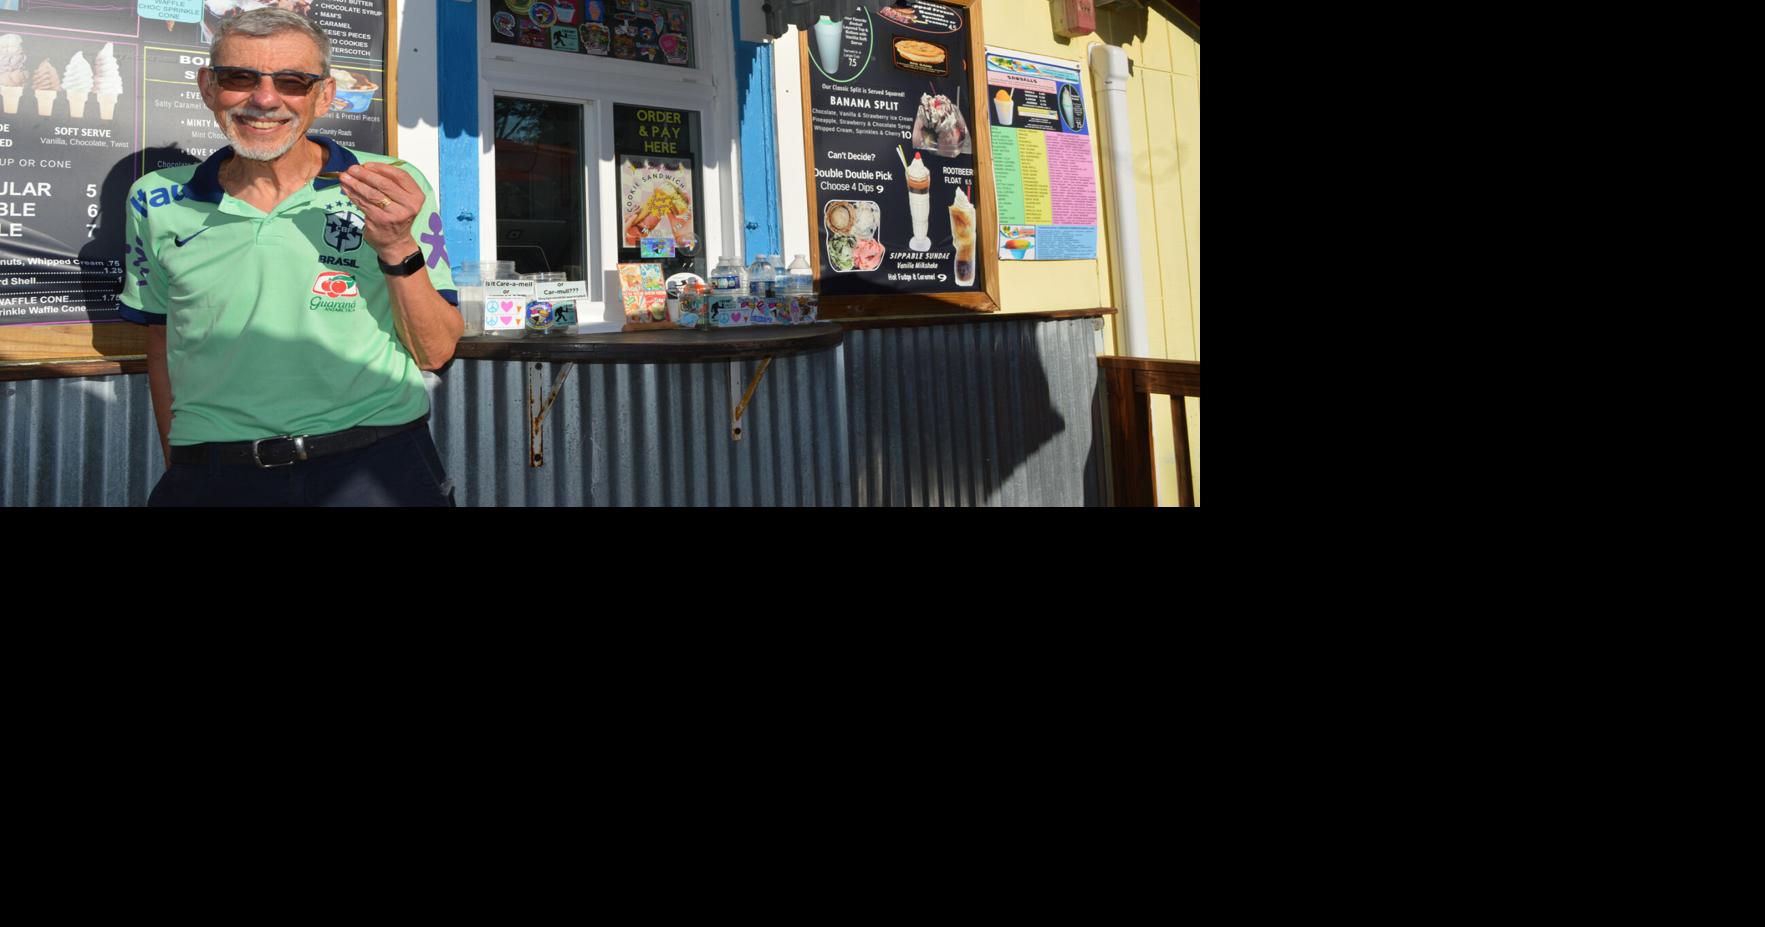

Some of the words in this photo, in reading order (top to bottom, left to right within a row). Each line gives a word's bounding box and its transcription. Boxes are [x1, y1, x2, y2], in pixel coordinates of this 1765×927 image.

[320, 3, 361, 14] CHOCOLATE
[362, 8, 382, 16] SYRUP
[319, 20, 352, 29] CARAMEL
[348, 32, 371, 40] PIECES
[339, 39, 368, 48] COOKIES
[830, 96, 871, 108] BANANA
[874, 100, 899, 111] SPLIT
[341, 112, 361, 120] Pretzel
[362, 114, 380, 122] Pieces
[637, 110, 681, 124] ORDER
[863, 113, 889, 121] Strawberry
[186, 119, 211, 127] MINTY
[839, 119, 866, 127] Strawberry
[54, 126, 79, 136] SOFT
[81, 127, 111, 138] SERVE
[319, 128, 337, 136] Country
[639, 125, 648, 137] &
[652, 126, 680, 138] PAY
[901, 130, 912, 139] 10
[186, 148, 207, 156] LOVE
[644, 141, 677, 154] HERE
[828, 151, 846, 160] Can't
[848, 152, 876, 161] Decide?
[19, 158, 35, 168] OR
[40, 160, 72, 168] CONE
[845, 169, 874, 180] Double
[875, 171, 892, 180] Pick
[943, 166, 974, 176] ROOTBEER
[86, 184, 97, 197] 5
[820, 181, 850, 191] Choose
[852, 183, 856, 191] 4
[858, 183, 874, 194] Dips
[876, 185, 884, 193] 9
[627, 182, 640, 213] COOKIE
[642, 173, 685, 189] SANDWICH
[87, 204, 98, 217] 6
[86, 224, 97, 238] 7
[889, 252, 923, 260] SIPPABLE
[924, 252, 950, 260] SUNDAE
[28, 258, 71, 266] Whipped
[319, 255, 360, 268] BRASIL
[937, 274, 947, 282] 9
[40, 296, 69, 304] CONE
[29, 306, 59, 314] Waffle
